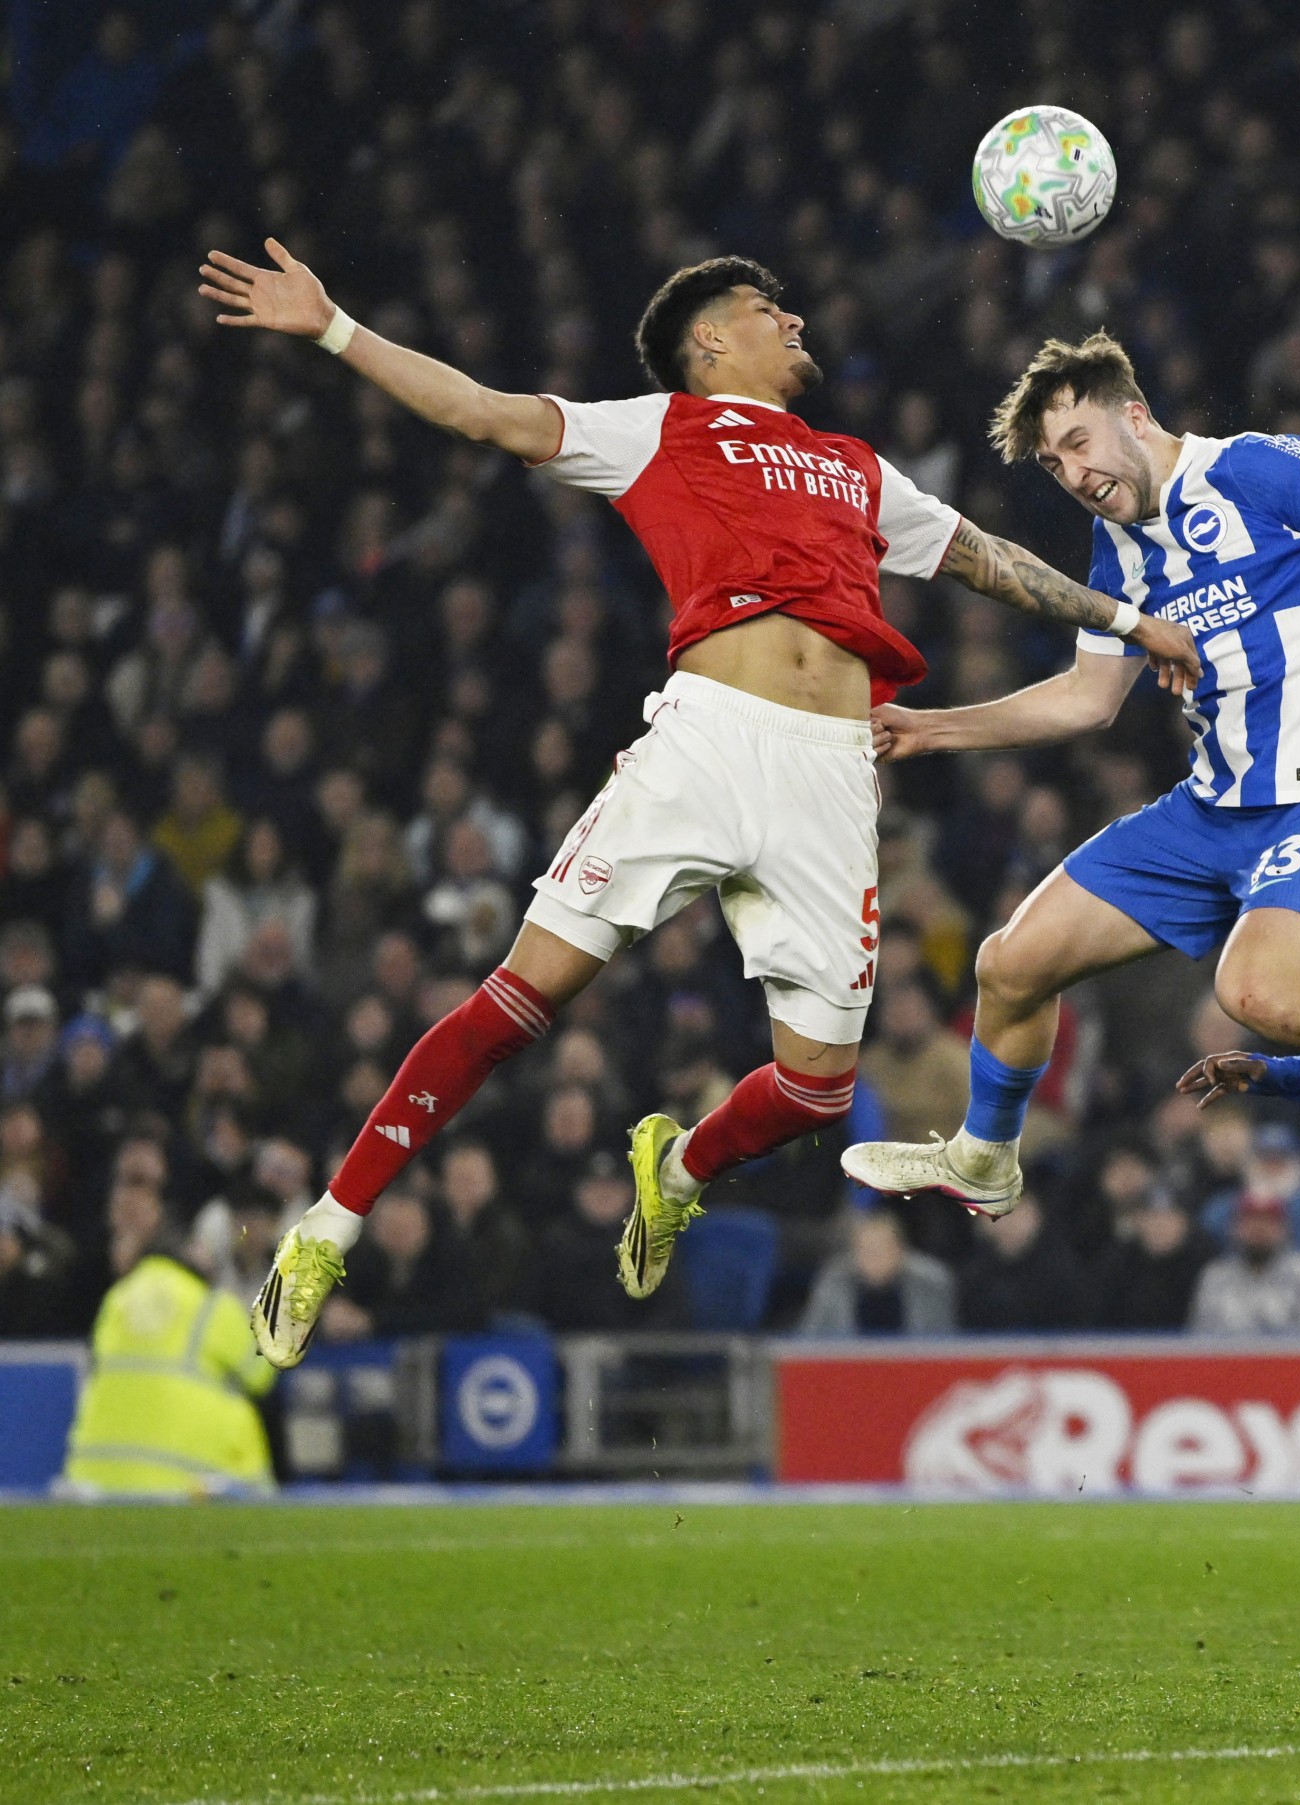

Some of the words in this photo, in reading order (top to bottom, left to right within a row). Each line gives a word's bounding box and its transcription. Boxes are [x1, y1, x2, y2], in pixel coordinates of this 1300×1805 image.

[762, 467, 796, 491] FLY
[804, 472, 869, 516] BETTER
[1153, 575, 1247, 622] MERICAN
[1178, 596, 1257, 637] RESS
[860, 885, 881, 952] 5
